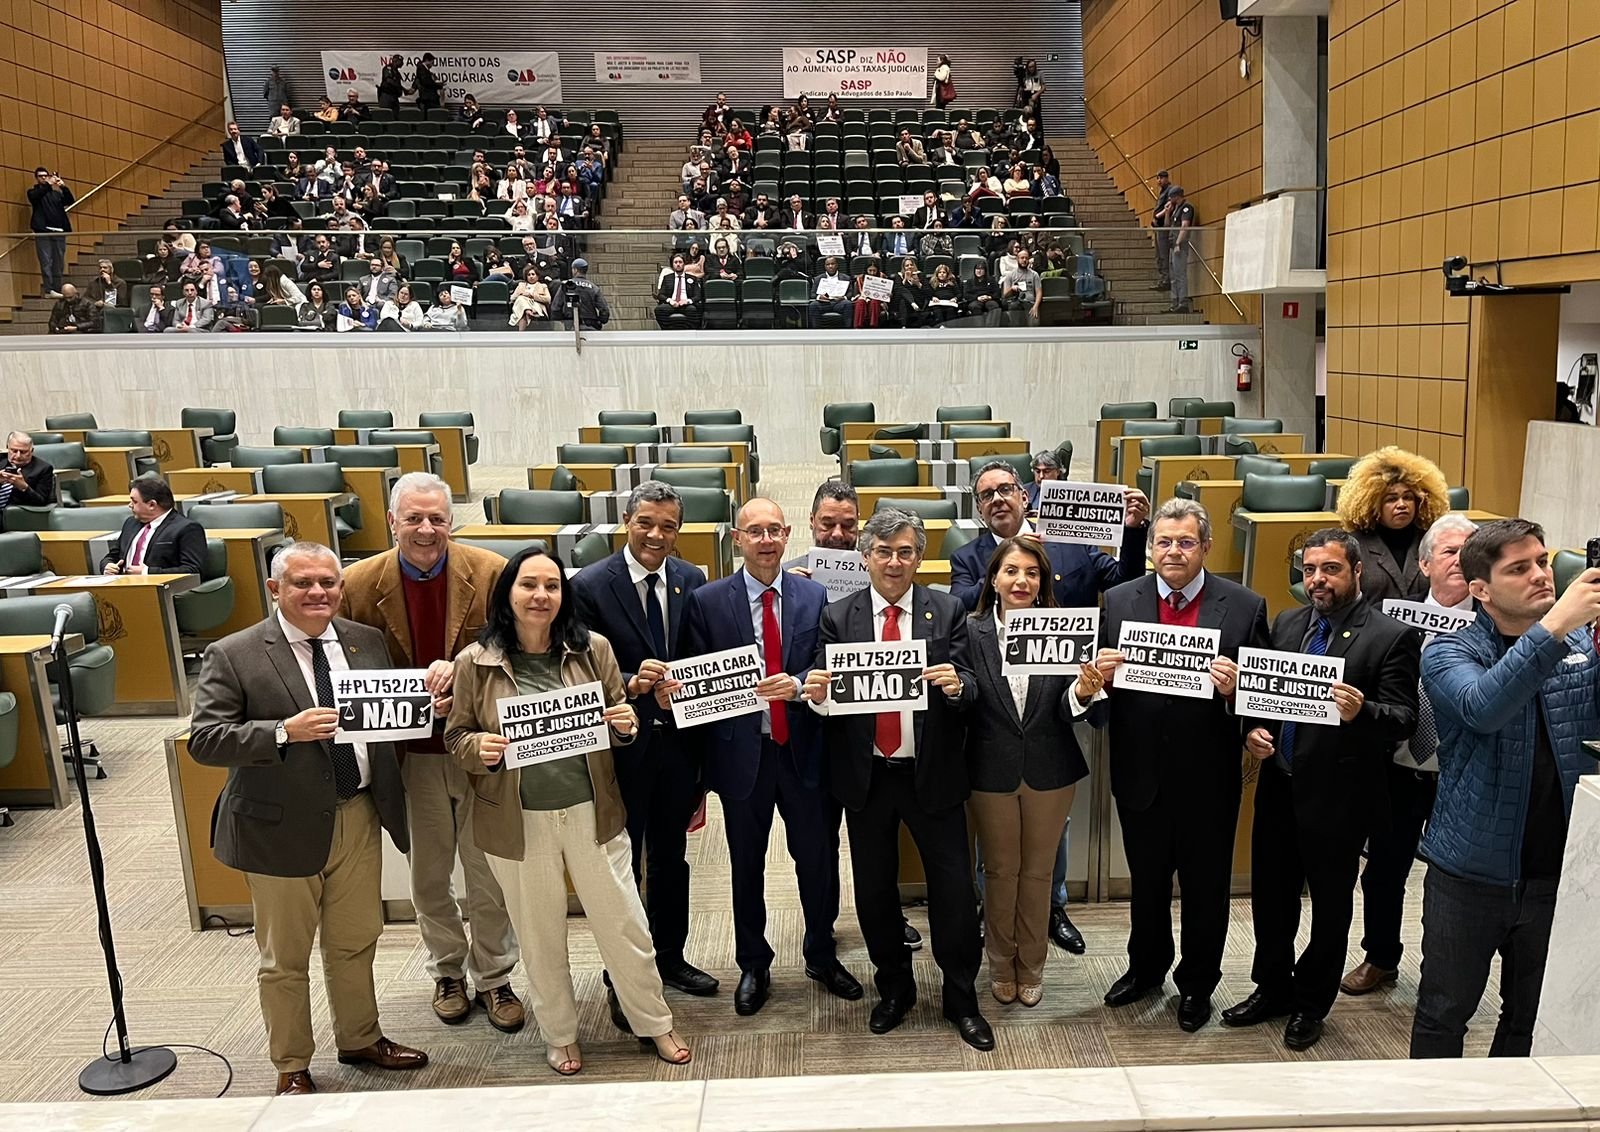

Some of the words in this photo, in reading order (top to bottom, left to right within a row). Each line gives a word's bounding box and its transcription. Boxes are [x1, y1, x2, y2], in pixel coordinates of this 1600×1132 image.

[406, 57, 421, 67] AO
[433, 57, 477, 67] UMENTO
[479, 57, 500, 67] DAS
[816, 50, 857, 64] SASP
[860, 56, 873, 64] DIZ
[876, 49, 906, 64] NÃO
[888, 65, 925, 73] JUDICIAIS
[840, 80, 872, 90] SASP
[1044, 488, 1090, 502] JUSTIÇA
[1093, 491, 1122, 504] CARA
[1042, 504, 1064, 517] NÃO
[1066, 505, 1073, 518] É
[1074, 507, 1120, 522] JUSTIÇA
[1074, 524, 1104, 532] CONTRA
[816, 559, 831, 569] PL
[835, 560, 855, 571] 752
[1009, 617, 1094, 632] #PL752/21
[1124, 629, 1176, 646] JUSTIÇA
[1180, 634, 1213, 650] CARA
[1026, 636, 1075, 663] NÃO
[723, 654, 756, 671] CARA
[831, 650, 921, 668] #PL752/21
[1121, 646, 1146, 663] NÃO
[1148, 649, 1157, 664] É
[1158, 652, 1211, 671] JUSTIÇA
[1140, 669, 1158, 677] SOU
[1158, 671, 1192, 681] CONTRA
[1242, 656, 1297, 675] JUSTIÇA
[1301, 663, 1337, 679] CARA
[338, 679, 428, 694] #PL752/21
[698, 681, 707, 695] É
[709, 672, 759, 693] JUSTIÇA
[853, 671, 903, 701] NÃO
[1126, 675, 1159, 685] CONTRA
[1167, 681, 1200, 690] PL752/21
[1240, 674, 1266, 690] NÃO
[1269, 677, 1278, 692] É
[1280, 681, 1335, 699] JUSTIÇA
[503, 699, 561, 720] JUSTIÇA
[564, 691, 600, 709] CARA
[696, 701, 713, 709] SOU
[713, 693, 748, 705] CONTRA
[1248, 703, 1283, 713] CONTRA
[1261, 697, 1279, 705] SOU
[1281, 700, 1316, 710] CONTRA
[362, 698, 413, 729] NÃO
[685, 708, 717, 719] CONTRA
[504, 723, 533, 740] NÃO
[535, 719, 545, 735] É
[547, 711, 602, 733] JUSTIÇA
[517, 743, 529, 751] EU
[530, 740, 549, 749] SOU
[550, 733, 586, 745] CONTRA
[518, 748, 554, 759] CONTRA
